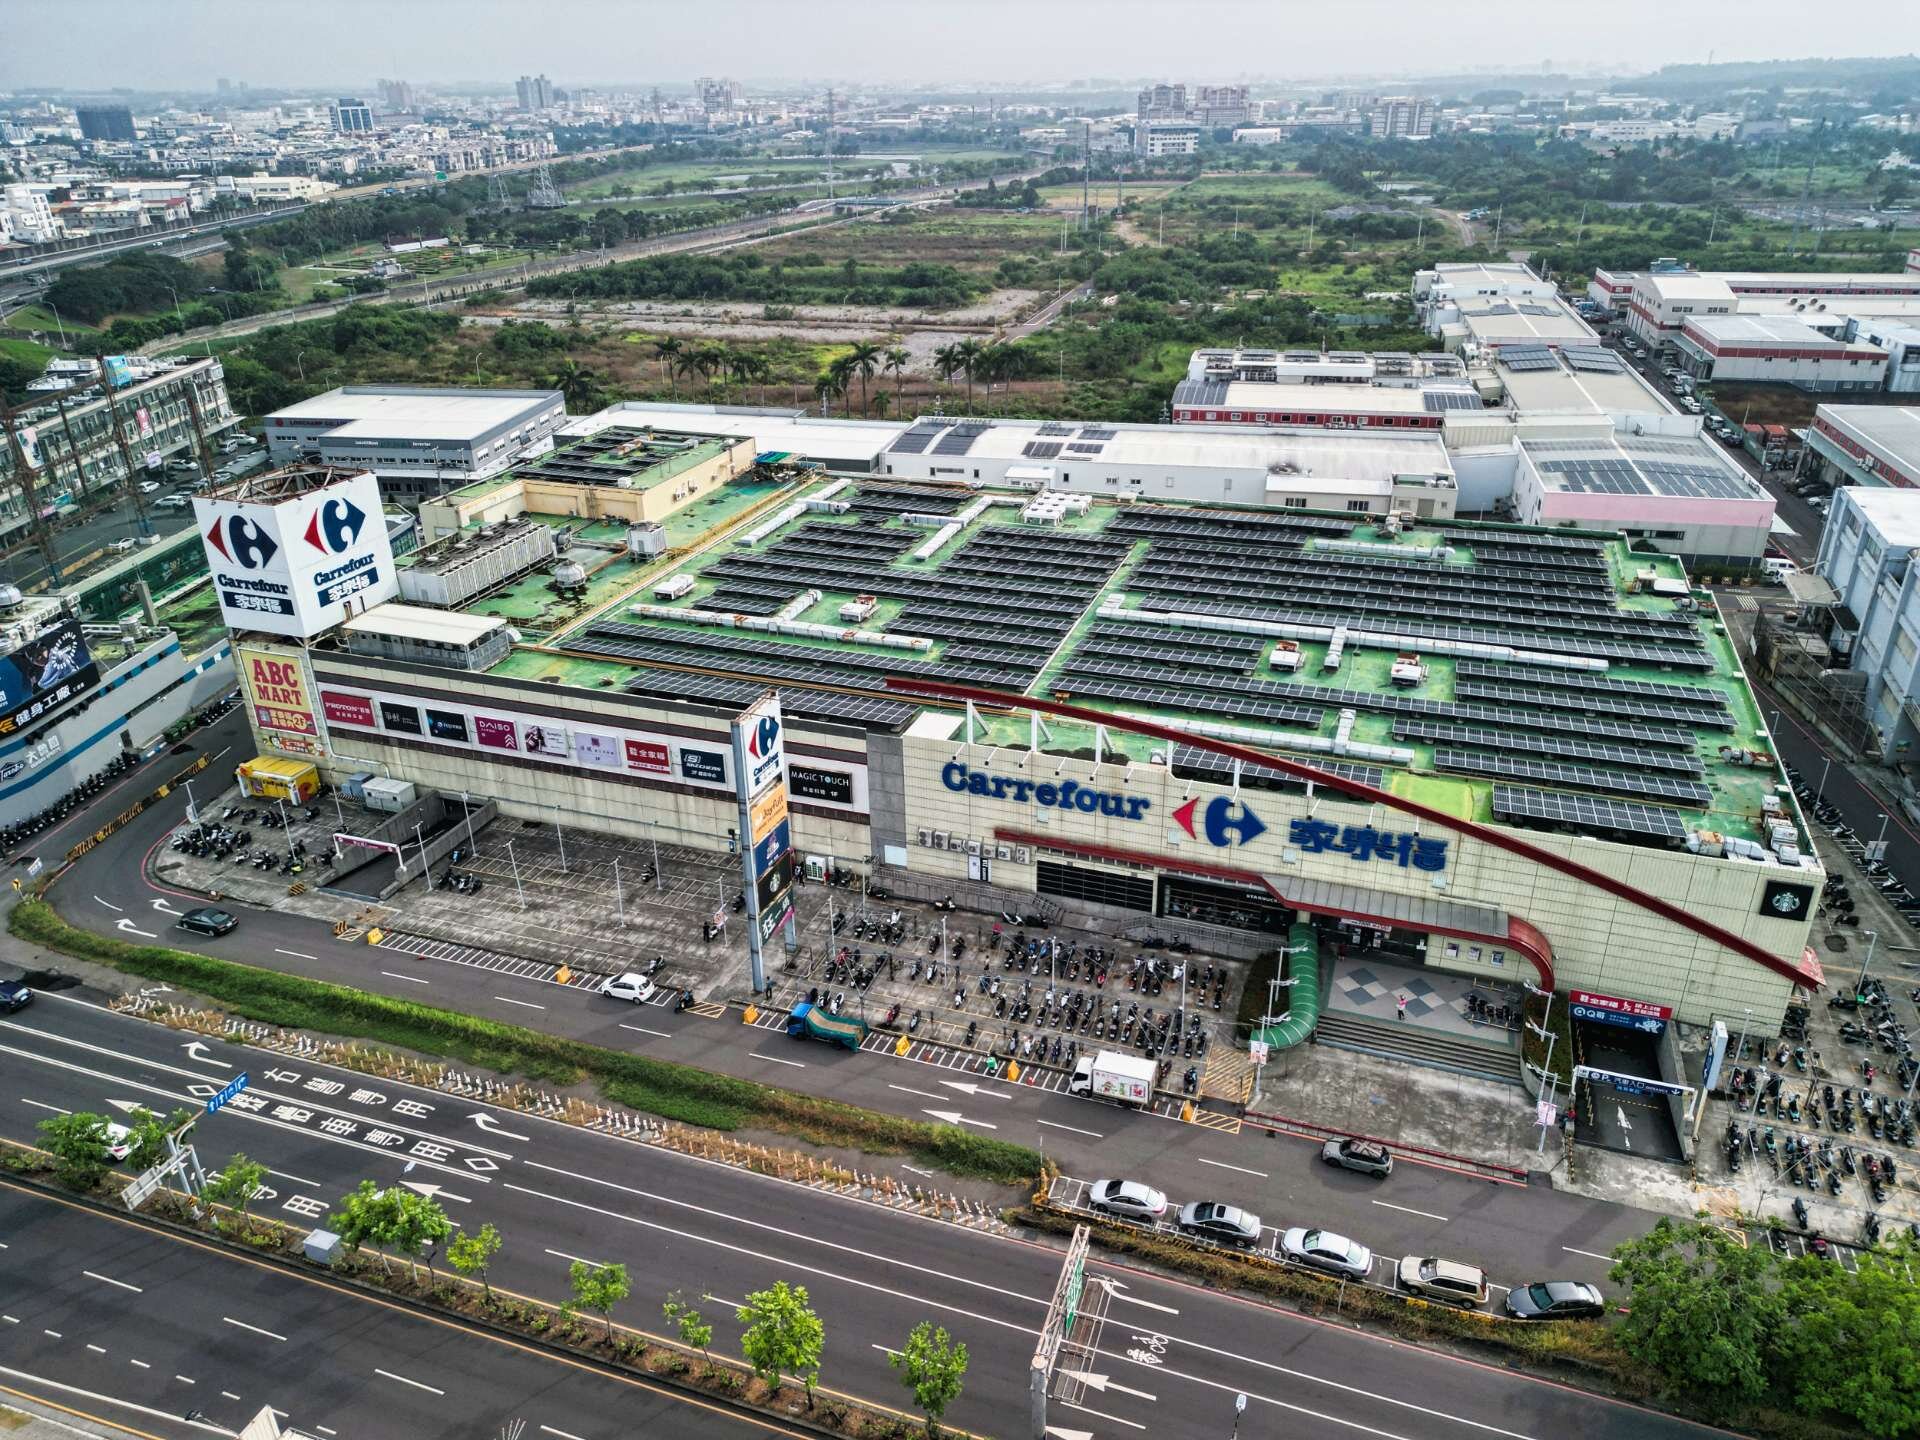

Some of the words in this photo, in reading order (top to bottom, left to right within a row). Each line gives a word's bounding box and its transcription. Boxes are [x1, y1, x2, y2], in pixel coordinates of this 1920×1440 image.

[314, 553, 374, 586] Carrefour
[217, 573, 289, 595] Carrefour
[253, 659, 298, 688] ABC
[256, 684, 302, 706] MART
[480, 721, 510, 731] DAISO
[753, 752, 779, 776] Carrefour
[820, 776, 849, 787] TOUCH
[942, 761, 1151, 822] Carrefour
[1289, 818, 1449, 873] 家樂福
